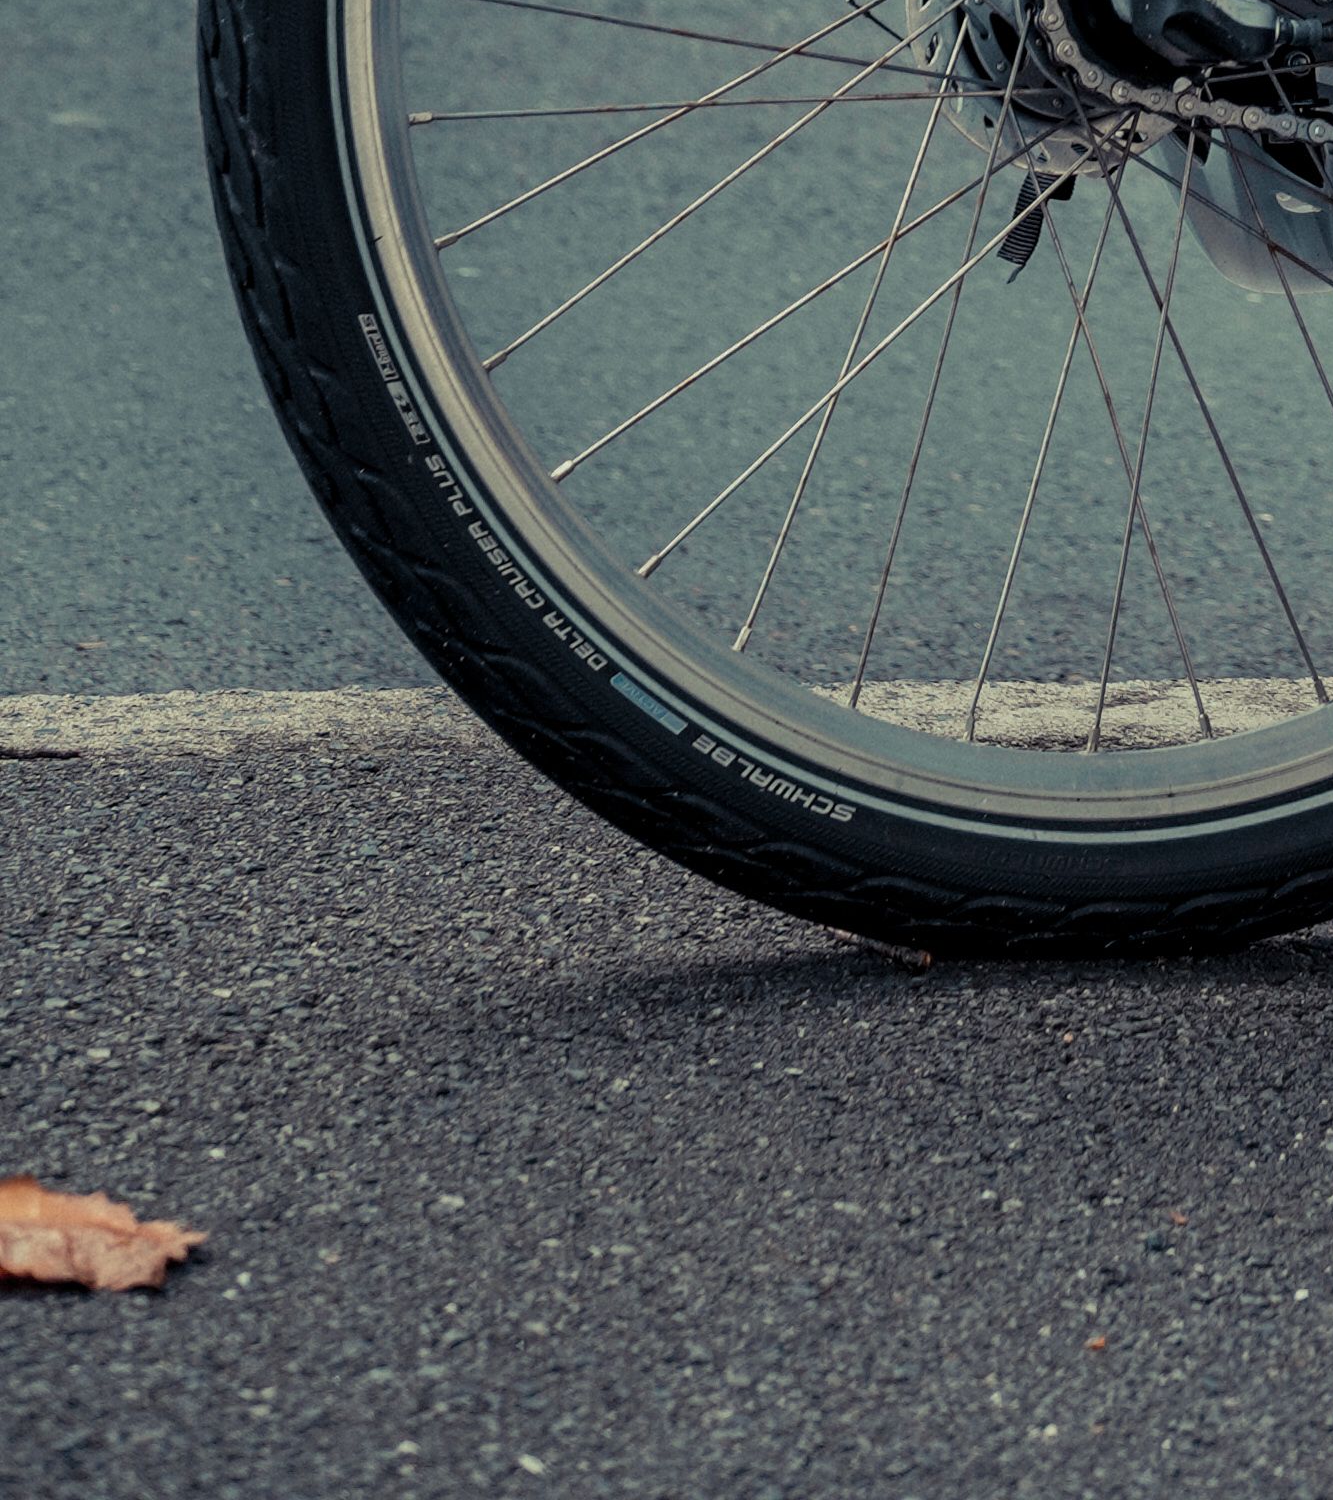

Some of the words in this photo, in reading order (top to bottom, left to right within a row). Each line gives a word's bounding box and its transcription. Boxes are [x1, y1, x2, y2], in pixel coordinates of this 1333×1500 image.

[424, 454, 474, 517] PLUS
[467, 520, 547, 610] CRUISER
[542, 613, 609, 672] DELTA
[692, 733, 857, 823] SCHWALBE
